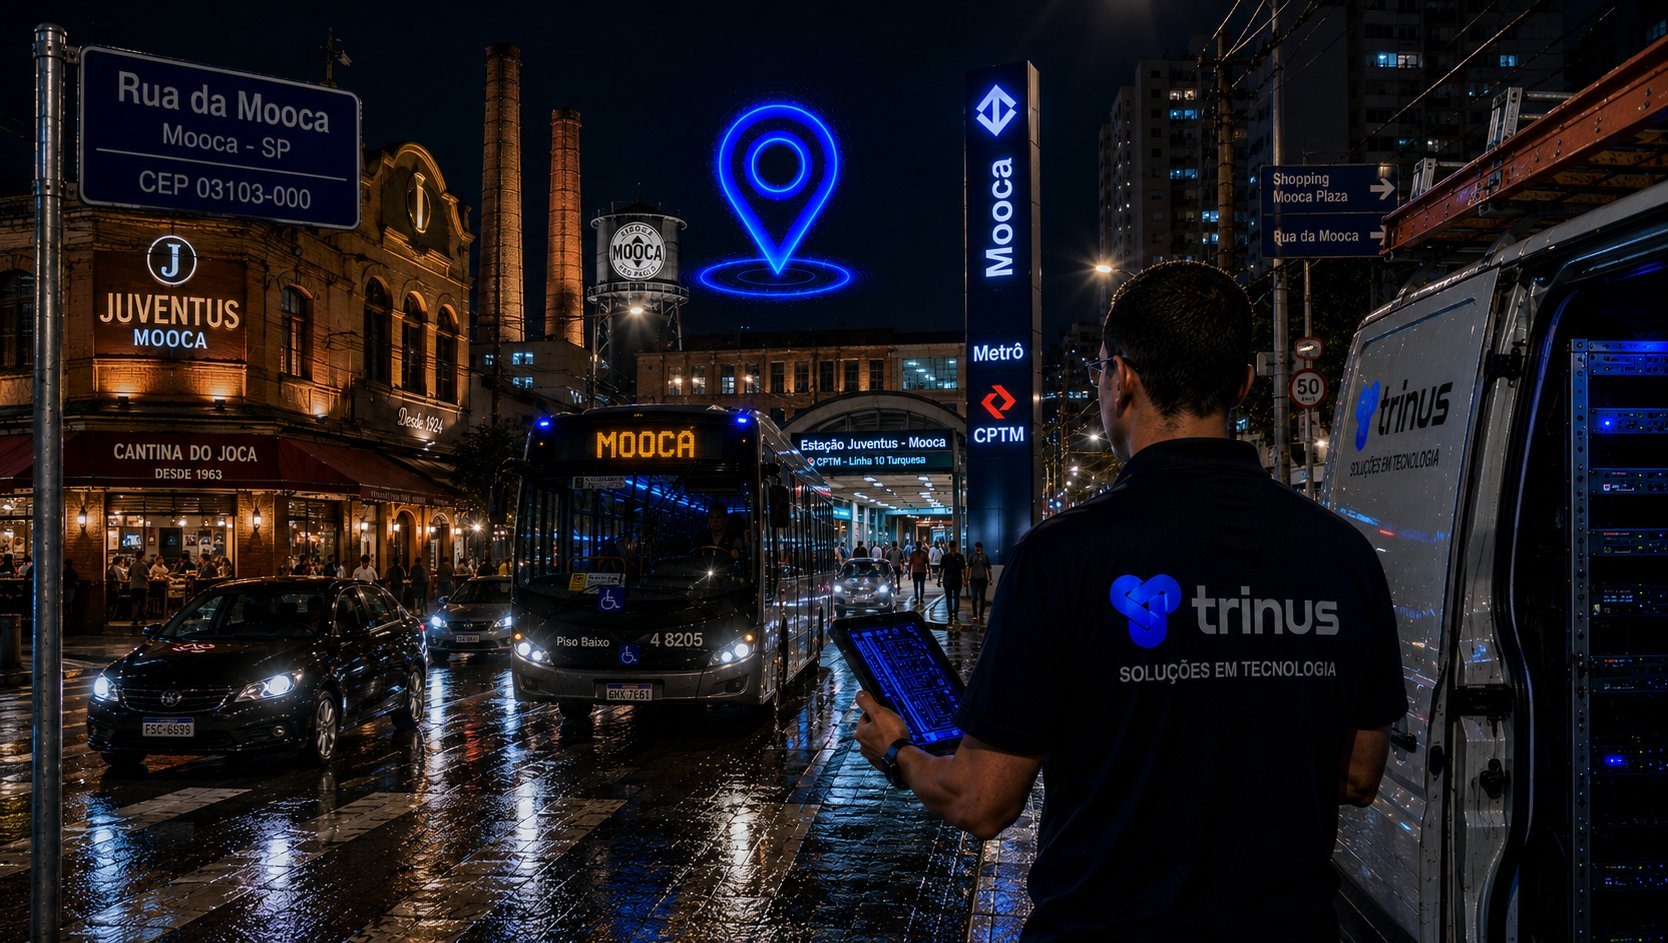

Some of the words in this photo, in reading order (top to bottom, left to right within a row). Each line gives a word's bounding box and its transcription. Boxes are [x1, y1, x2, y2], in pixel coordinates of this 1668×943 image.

[118, 70, 180, 111] Rua
[190, 84, 227, 118] da
[237, 90, 330, 134] Mooca
[162, 122, 239, 154] Mooca
[261, 136, 291, 159] SP
[138, 170, 189, 196] CEP
[196, 177, 311, 210] 03103-000
[1273, 172, 1330, 188] Shopping
[1273, 190, 1313, 204] Mooca
[1316, 189, 1348, 203] Plaza
[985, 157, 1014, 278] Mooca
[1273, 228, 1297, 243] Rua
[1300, 230, 1315, 242] da
[1319, 229, 1360, 242] Mooca
[160, 243, 181, 278] J
[612, 243, 662, 261] MOOCA
[99, 292, 240, 329] JUVENTUS
[133, 328, 208, 350] MOOCA
[973, 342, 1024, 362] Metrô
[1297, 378, 1319, 395] 50
[1377, 379, 1453, 436] trinus
[397, 407, 424, 430] Desde
[425, 415, 443, 435] 1924
[596, 430, 695, 458] MOOCA
[800, 439, 845, 453] Estação
[847, 437, 898, 450] Juventus
[908, 436, 946, 449] Mooca
[974, 426, 1025, 443] CPTM
[113, 443, 183, 461] CANTINA
[190, 445, 212, 461] DO
[217, 446, 258, 462] JOCA
[816, 457, 841, 467] CPTM
[848, 456, 872, 466] Linha
[875, 456, 885, 466] 10
[887, 455, 926, 467] Turquesa
[1381, 455, 1393, 473] EM
[1393, 448, 1440, 471] TECNOLOGIA
[155, 468, 192, 480] DESDE
[195, 469, 223, 480] 1963
[1191, 584, 1340, 636] trinus
[556, 635, 578, 647] Piso
[581, 636, 610, 648] Baixo
[650, 633, 661, 647] 4
[664, 632, 703, 647] 8205
[1119, 659, 1211, 685] SOLUÇÕES
[1215, 661, 1238, 678] EM
[1241, 660, 1337, 677] TECNOLOGIA
